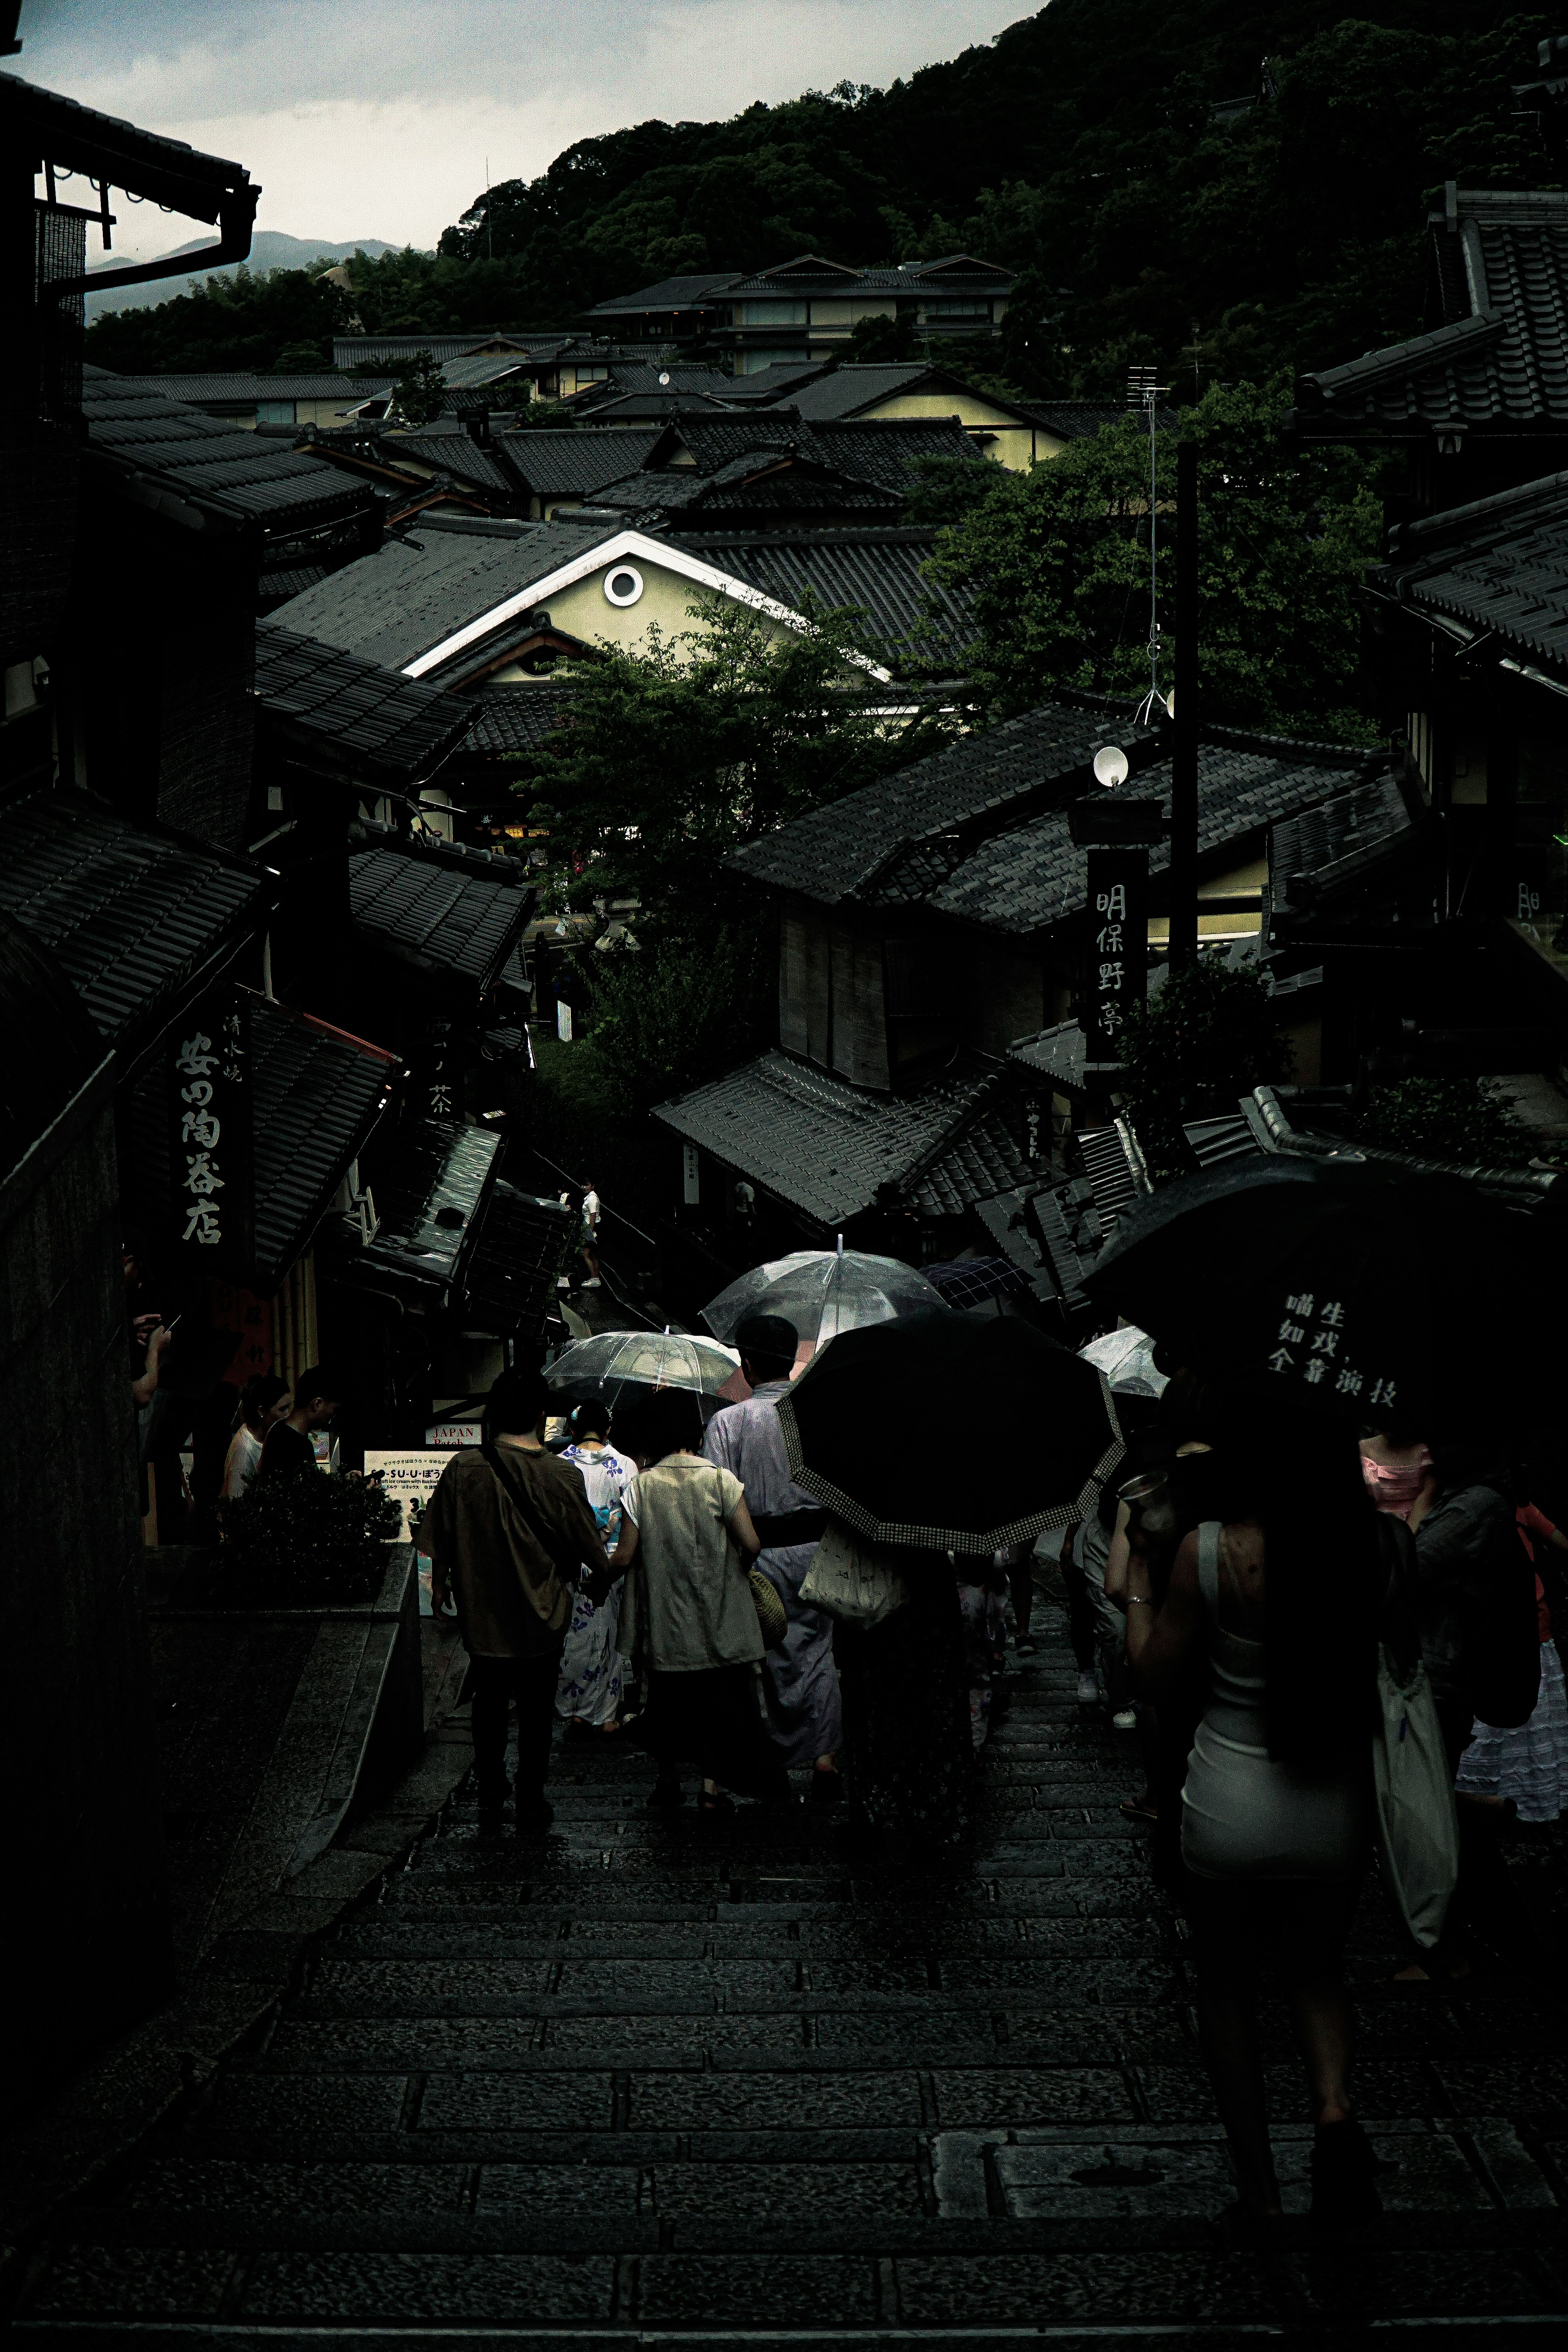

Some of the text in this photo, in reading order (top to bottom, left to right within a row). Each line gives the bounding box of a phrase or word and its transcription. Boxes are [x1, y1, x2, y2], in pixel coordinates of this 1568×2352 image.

[1096, 884, 1126, 1036] 明保野亭
[223, 1015, 243, 1083] 清水焼
[175, 1032, 225, 1245] 安田陶器店
[1267, 1348, 1398, 1408] 全靠演技
[433, 1428, 474, 1438] JAPAN
